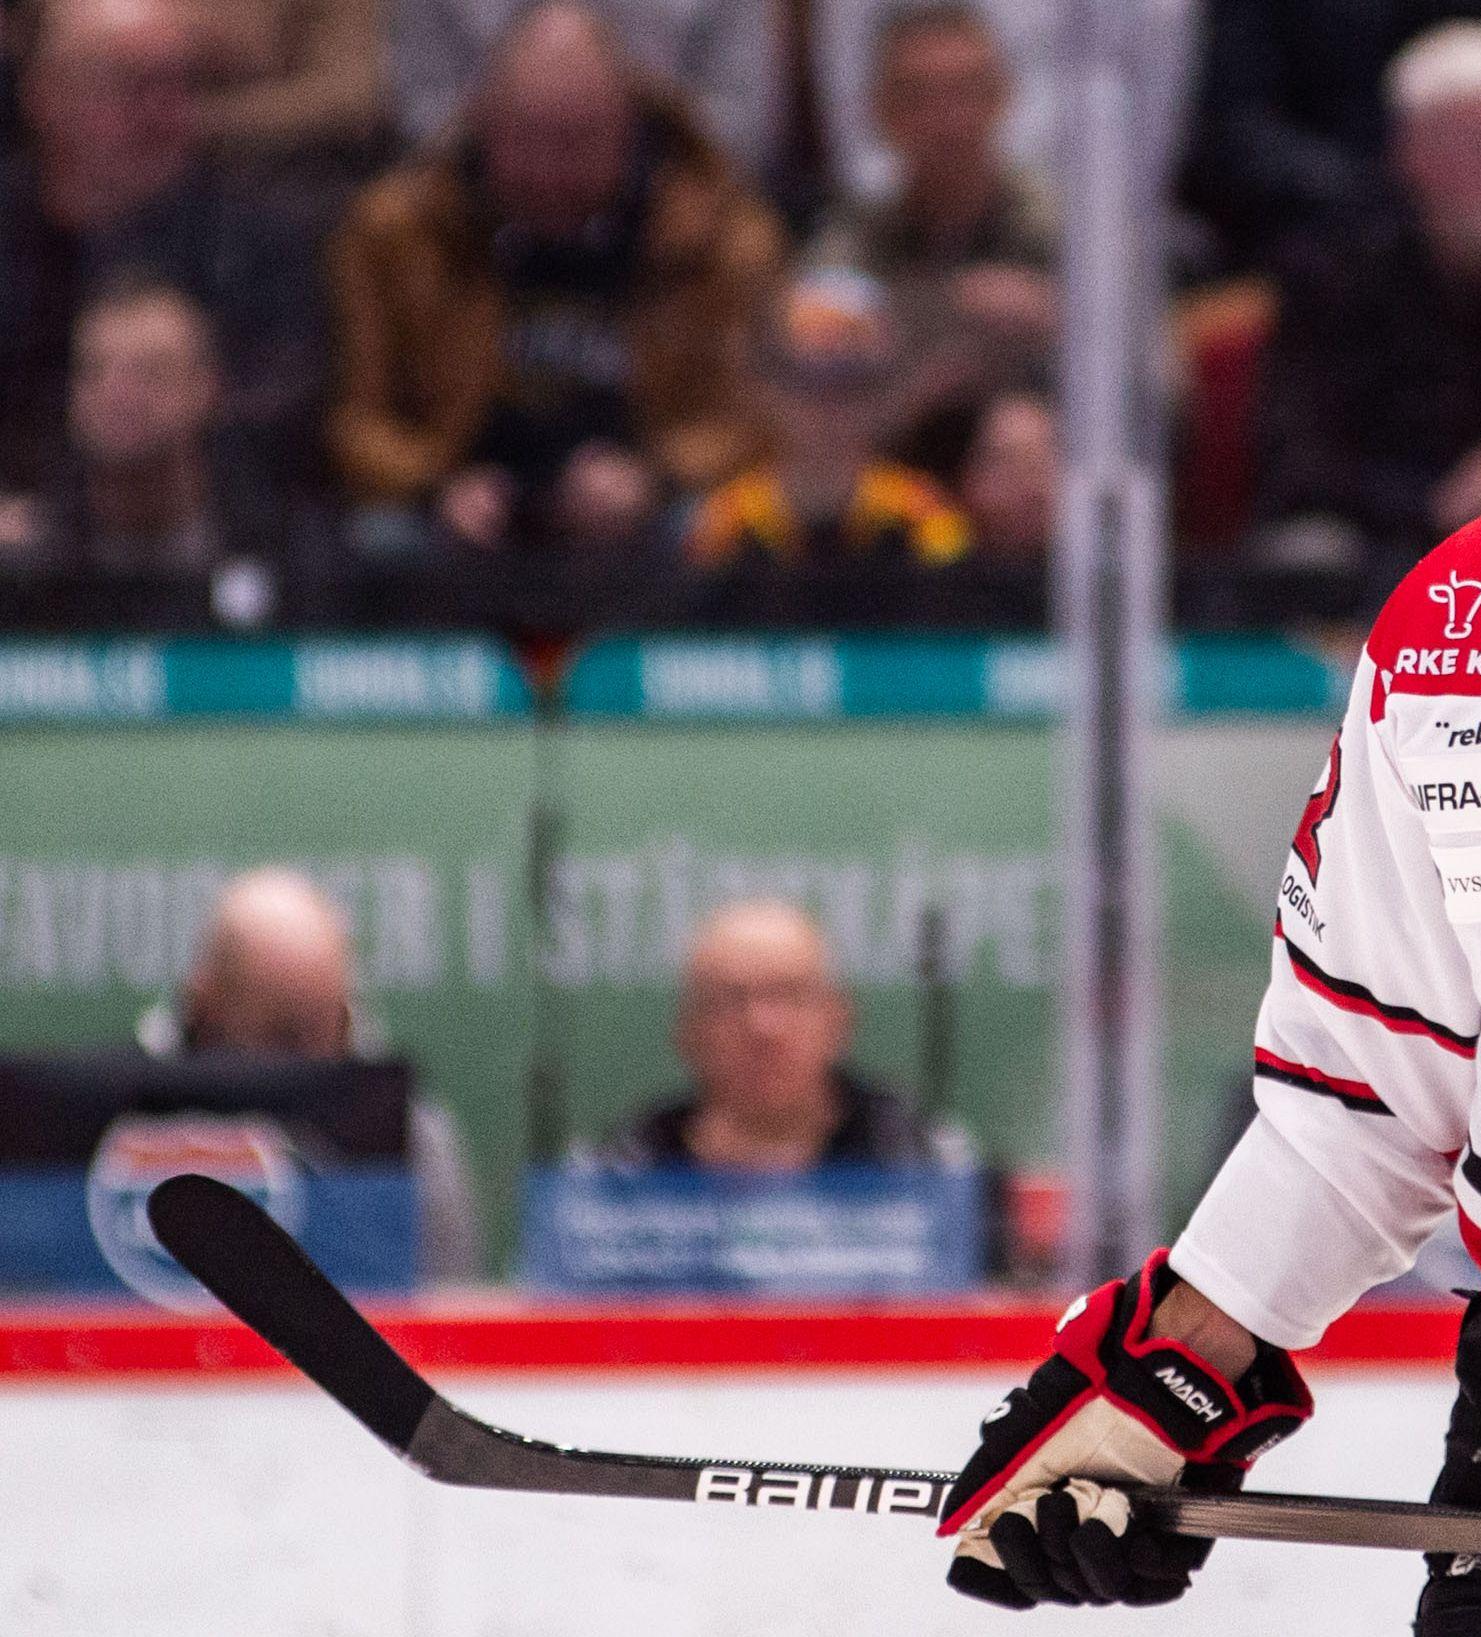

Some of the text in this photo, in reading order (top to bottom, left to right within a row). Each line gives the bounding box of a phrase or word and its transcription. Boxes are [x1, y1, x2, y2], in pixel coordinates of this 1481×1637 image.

[1394, 647, 1460, 676] RKE
[1281, 875, 1327, 943] OGISTIK
[1155, 1366, 1223, 1423] MACH
[695, 1466, 955, 1520] BAUE
